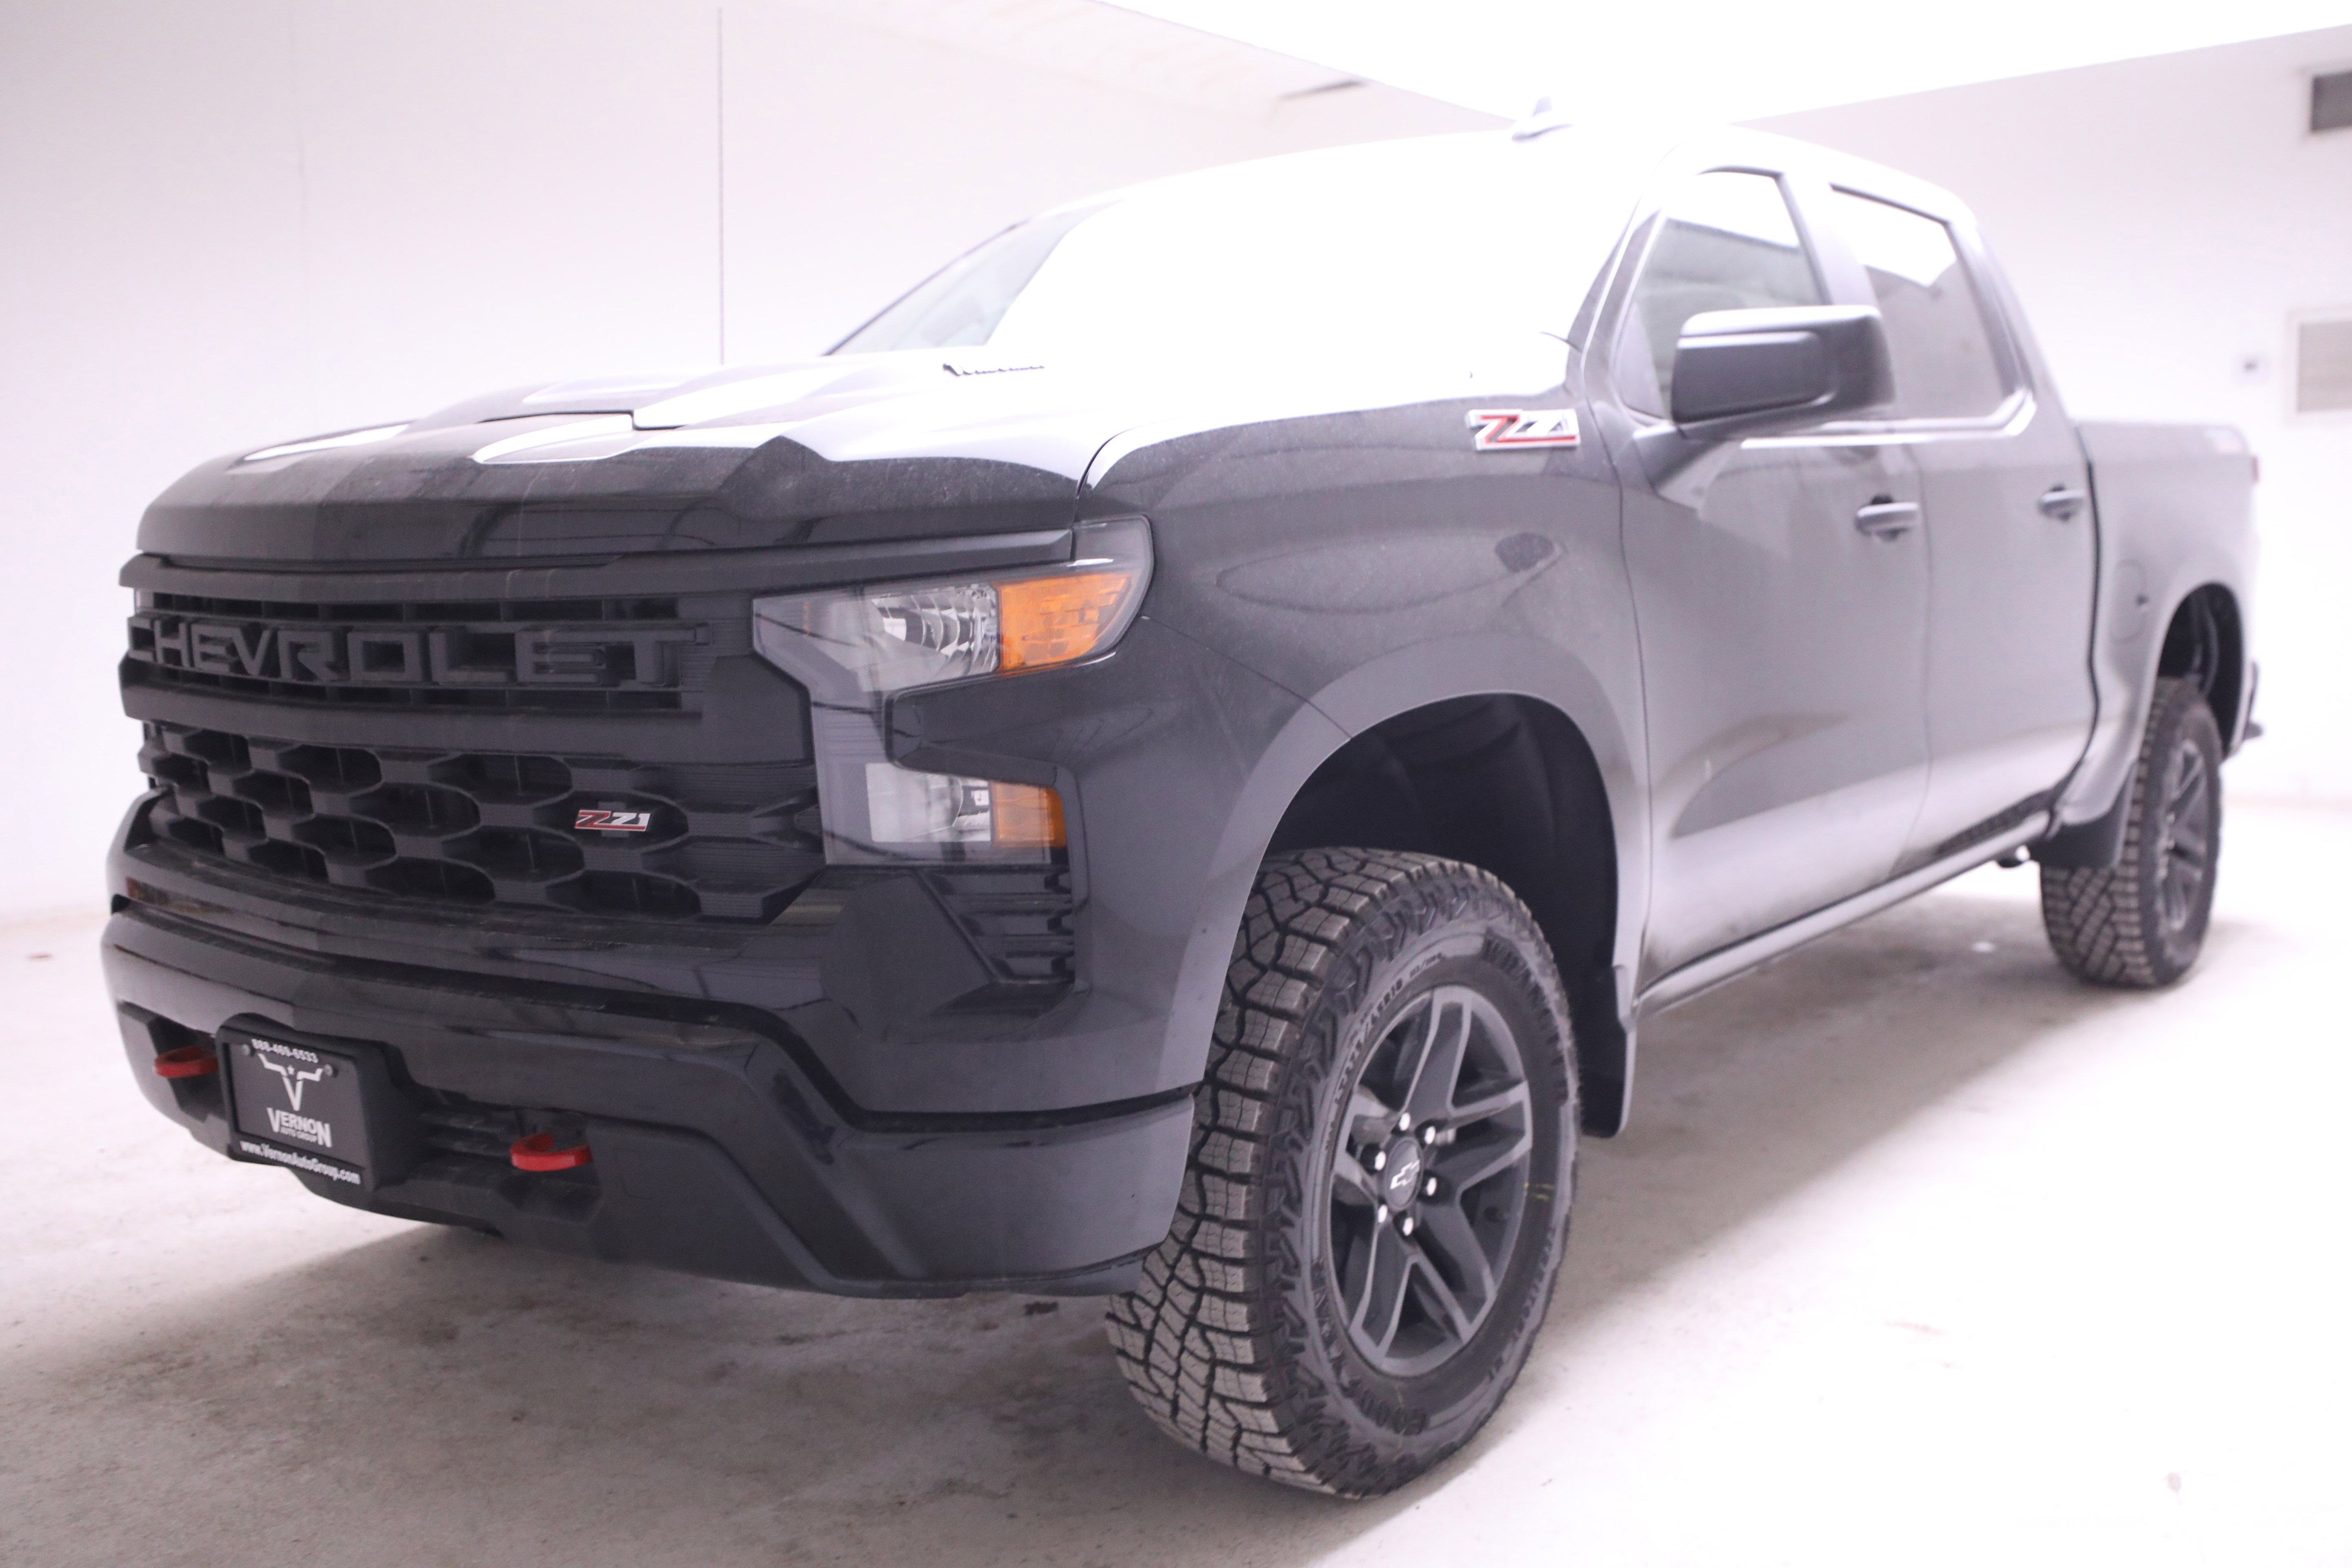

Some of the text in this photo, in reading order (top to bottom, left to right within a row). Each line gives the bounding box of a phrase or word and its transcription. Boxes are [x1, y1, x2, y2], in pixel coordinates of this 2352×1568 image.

[1466, 409, 1580, 450] Z71
[128, 615, 710, 688] CHEVROLET
[575, 810, 651, 831] Z71
[267, 1107, 332, 1147] VERNON
